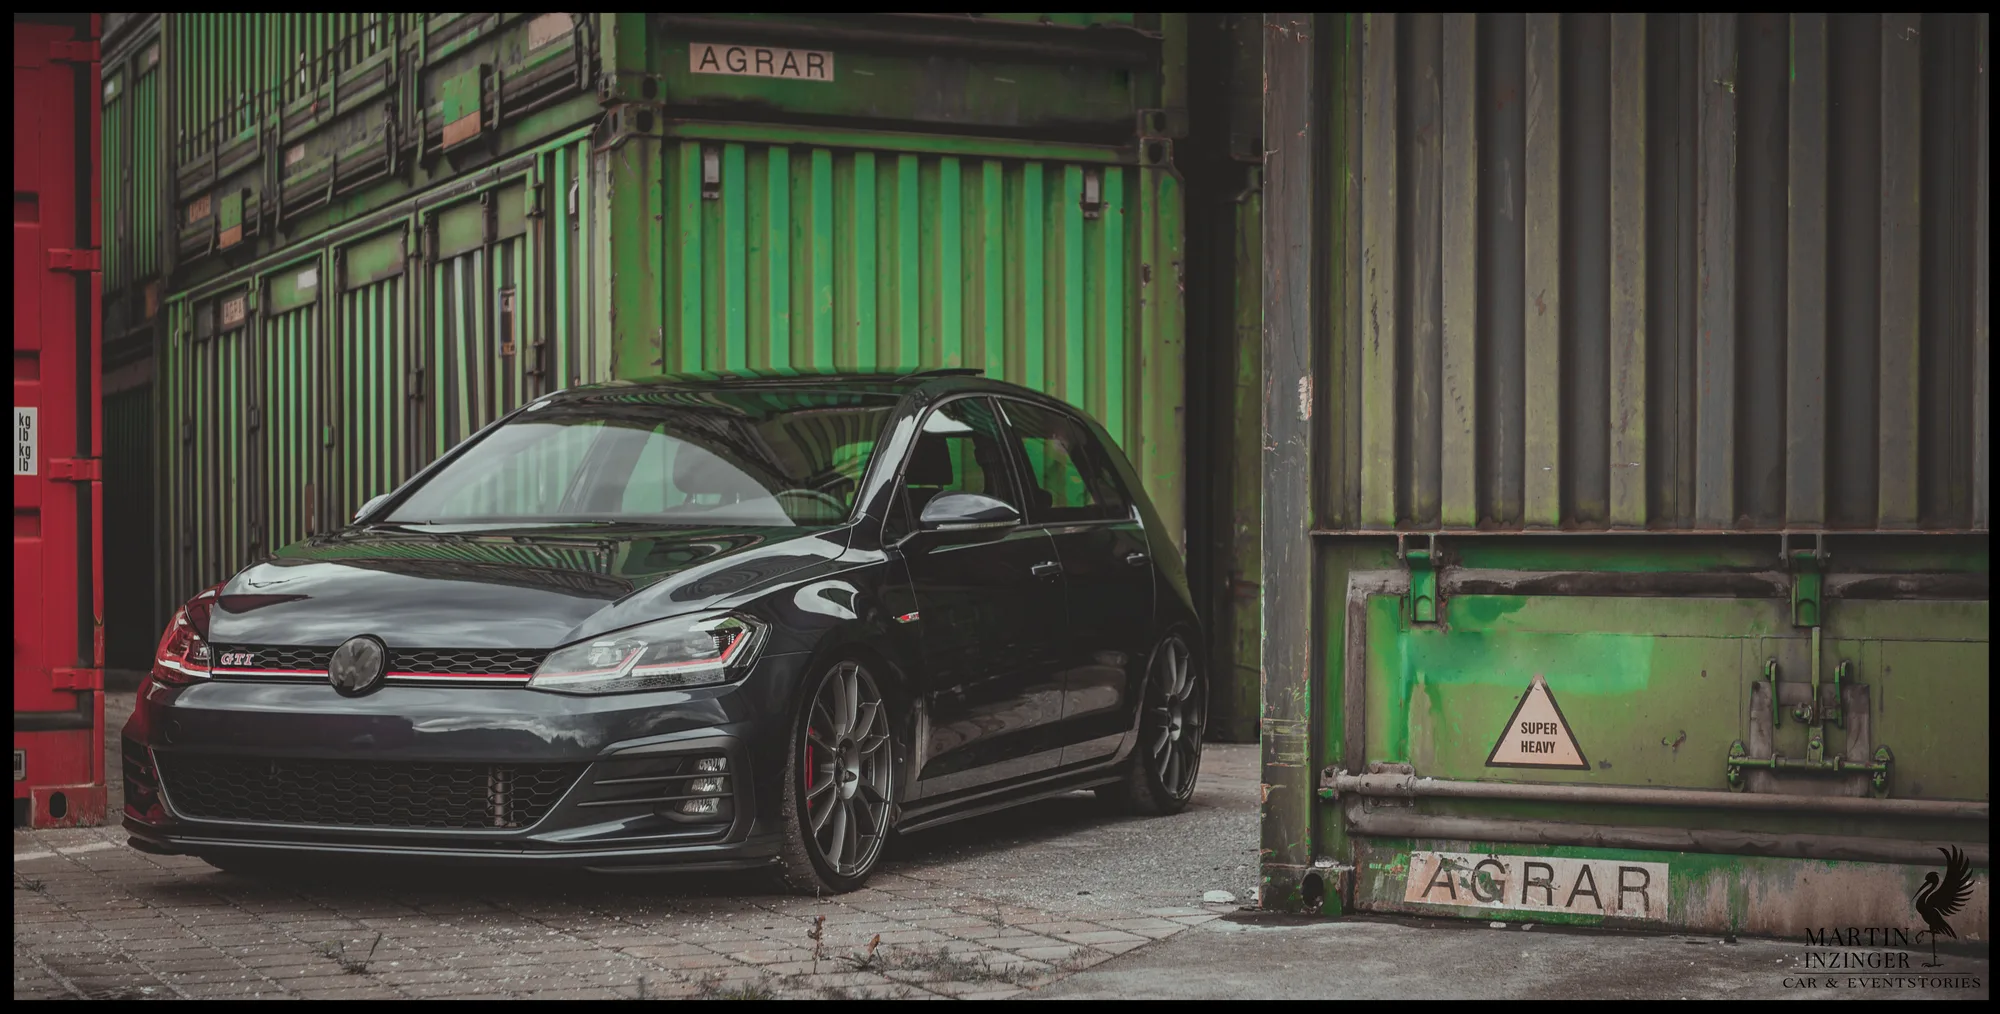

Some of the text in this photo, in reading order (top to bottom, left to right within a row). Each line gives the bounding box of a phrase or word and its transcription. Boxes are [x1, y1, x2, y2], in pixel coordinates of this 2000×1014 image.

[698, 45, 825, 79] AGRAR
[18, 412, 31, 430] kg
[18, 427, 29, 442] lb
[18, 442, 31, 460] kg
[18, 457, 29, 472] lb
[220, 652, 254, 665] GTI
[1520, 721, 1558, 736] SUPER
[1520, 740, 1556, 754] HEAVY
[1421, 857, 1651, 913] AGRAR
